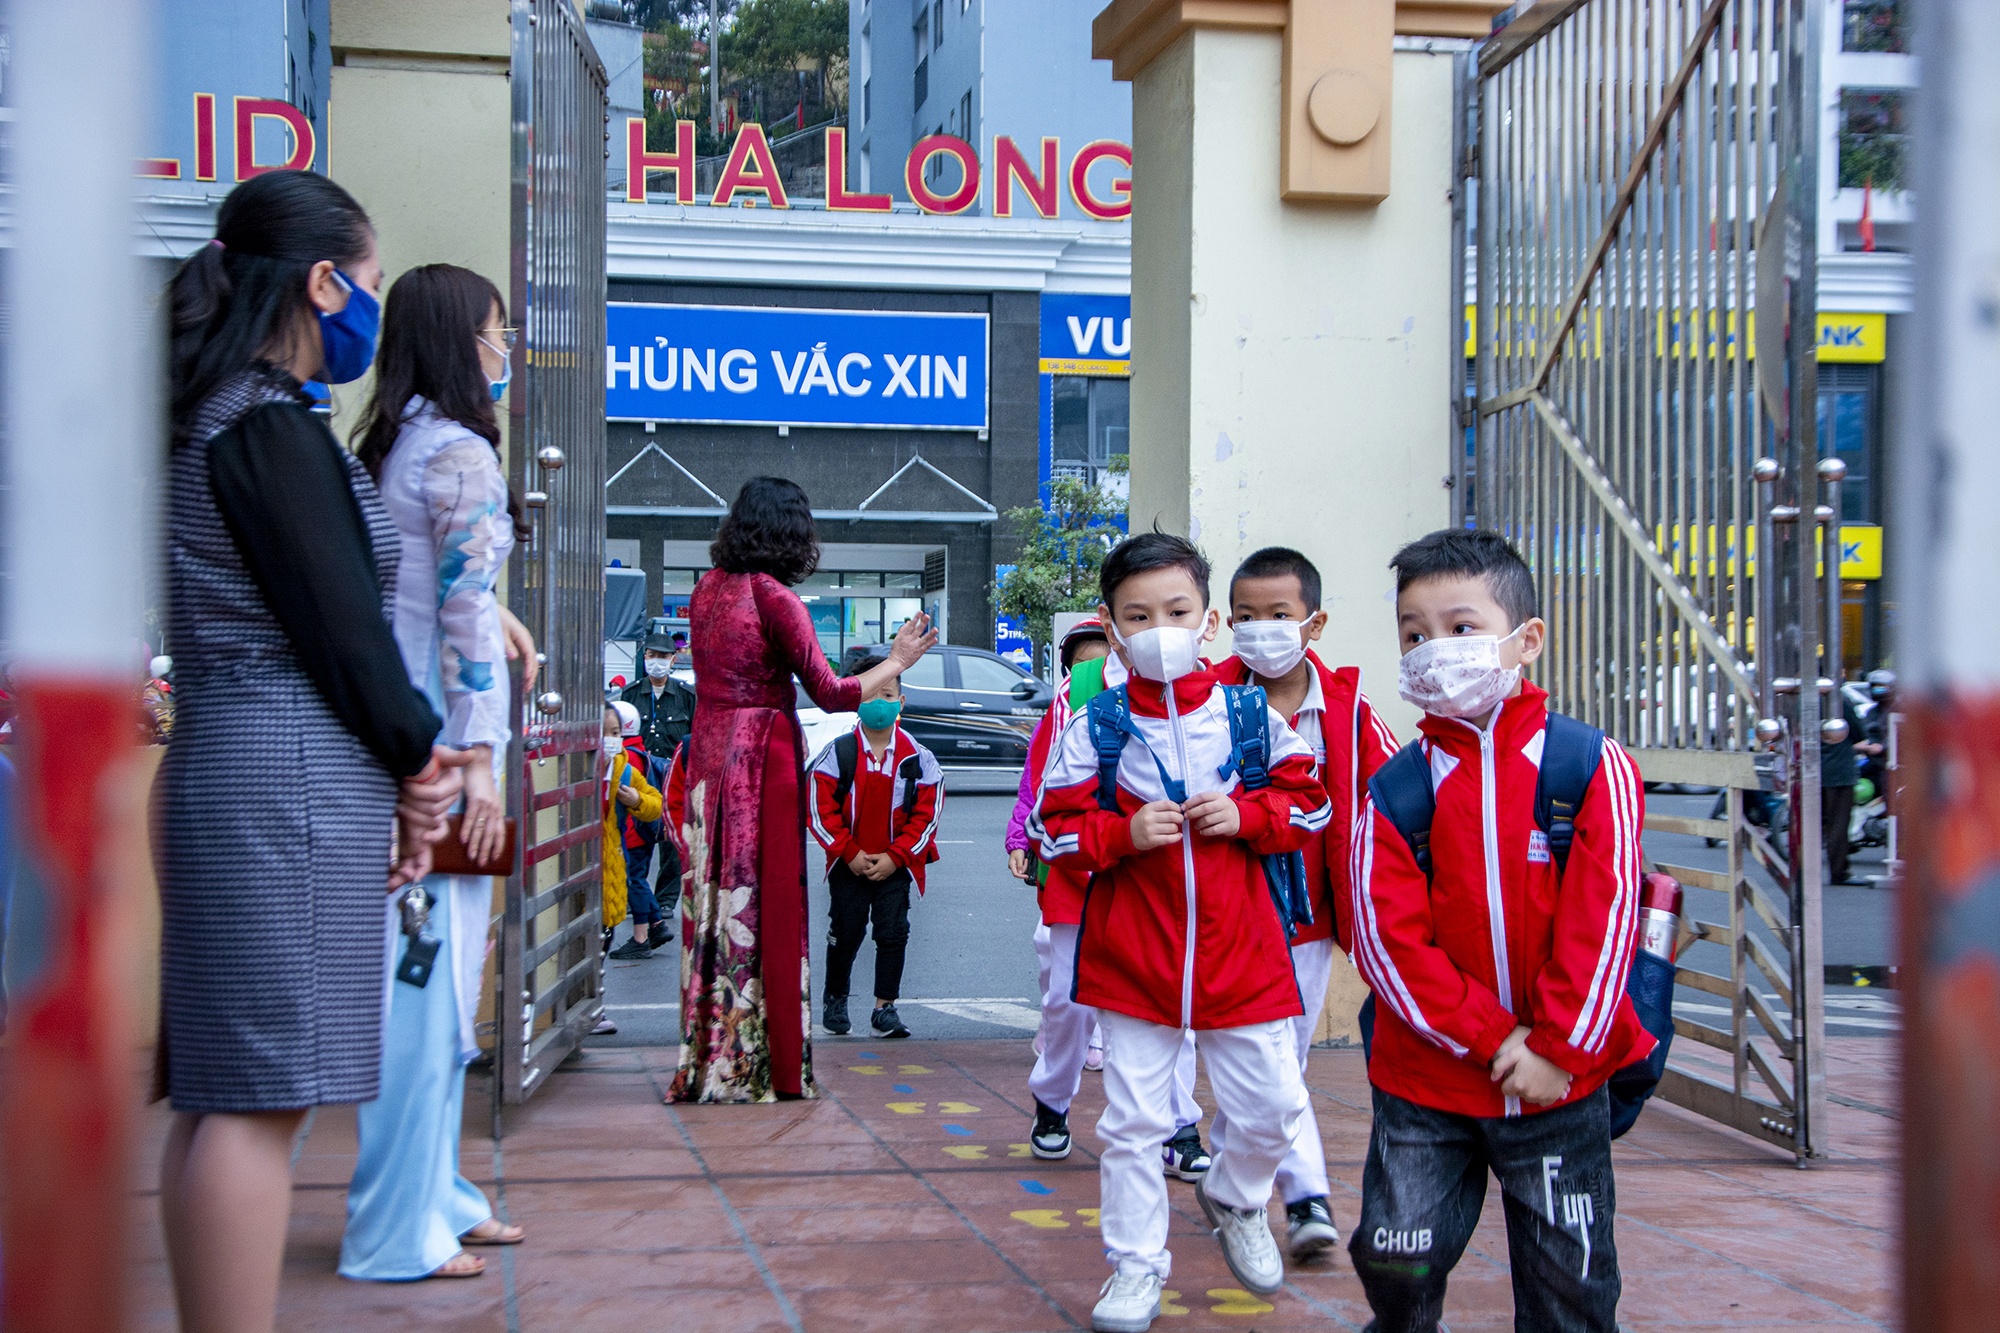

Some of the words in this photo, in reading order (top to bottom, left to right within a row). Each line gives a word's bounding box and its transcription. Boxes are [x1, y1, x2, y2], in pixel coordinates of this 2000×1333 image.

[626, 117, 790, 209] HẠ
[825, 126, 1132, 221] LONG
[606, 336, 758, 393] HỦNG
[770, 341, 872, 396] VẮC
[881, 354, 967, 399] XIN
[997, 622, 1009, 640] 5
[1373, 1227, 1432, 1254] CHUB
